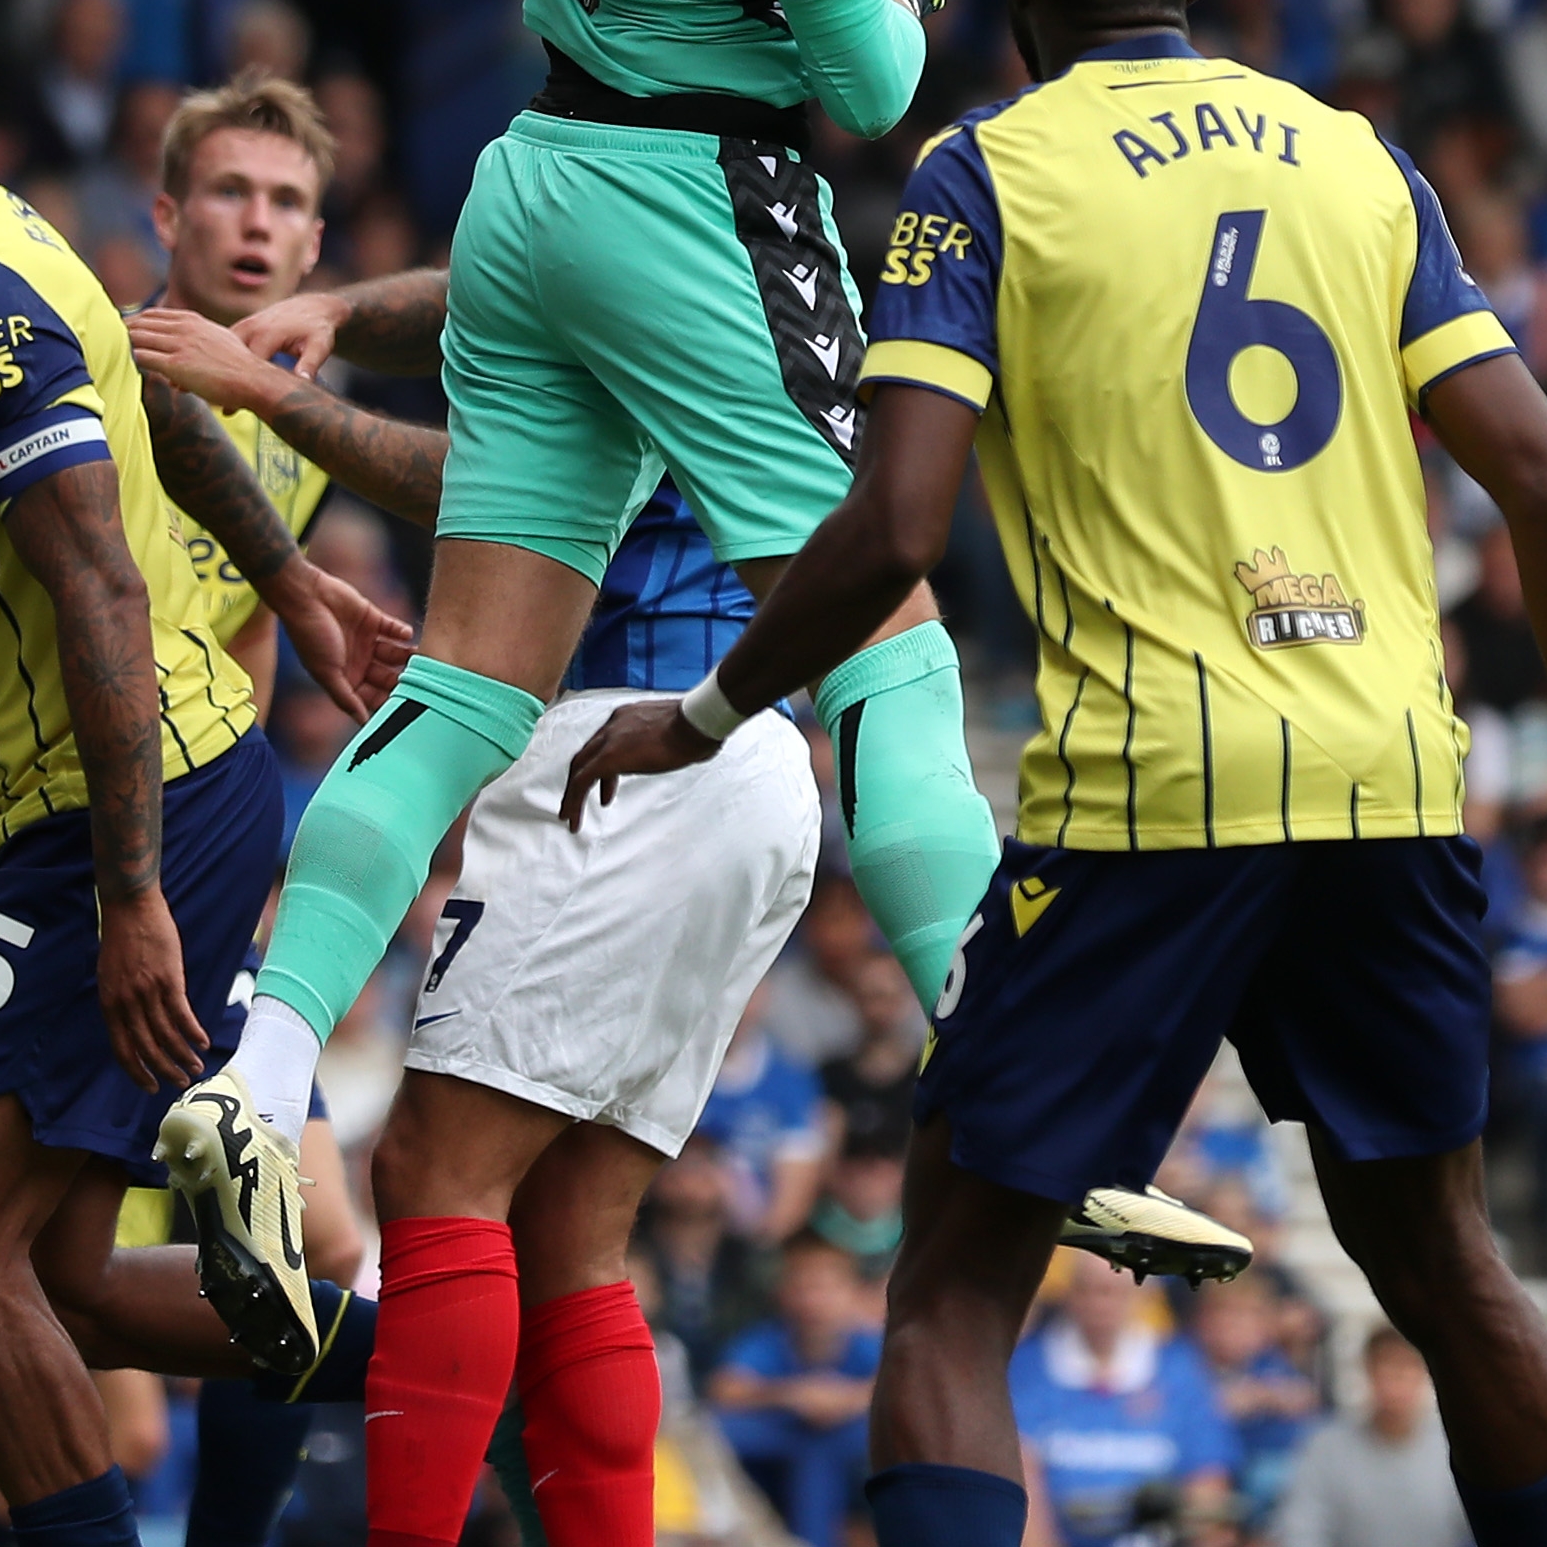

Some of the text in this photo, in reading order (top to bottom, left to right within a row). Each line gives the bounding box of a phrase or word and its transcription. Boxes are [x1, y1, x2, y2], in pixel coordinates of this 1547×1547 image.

[1112, 102, 1301, 179] AJAYI
[890, 211, 973, 260] BER
[1185, 209, 1342, 473] 6
[9, 428, 71, 464] CAPTAIN
[1254, 574, 1348, 608] MEGA
[1258, 611, 1355, 643] RICHES
[425, 899, 485, 993] 7
